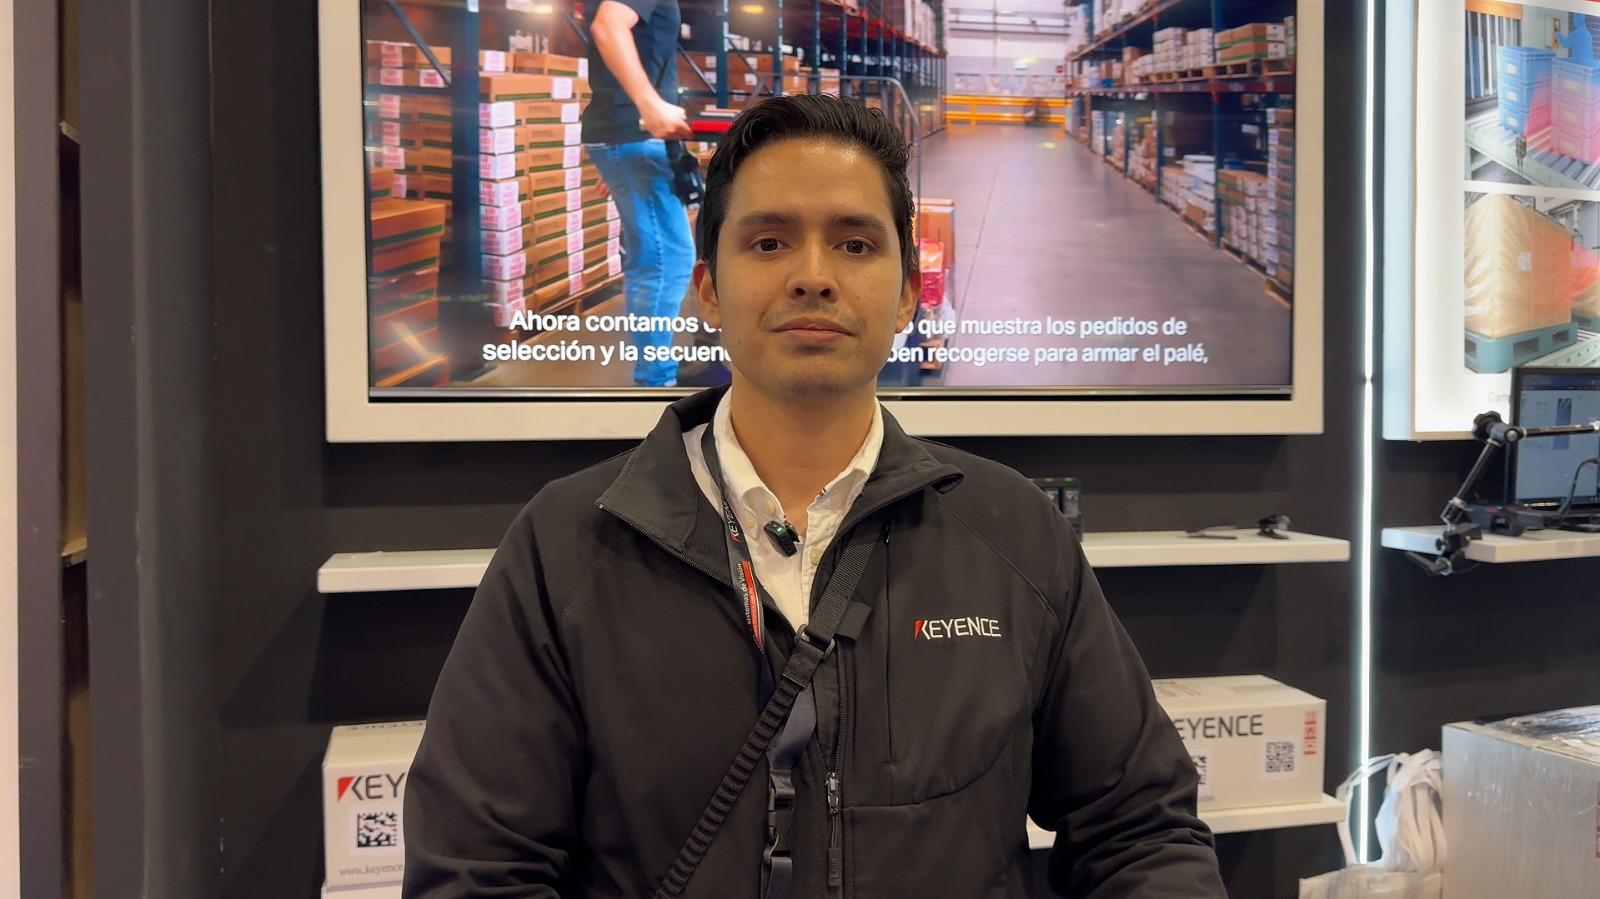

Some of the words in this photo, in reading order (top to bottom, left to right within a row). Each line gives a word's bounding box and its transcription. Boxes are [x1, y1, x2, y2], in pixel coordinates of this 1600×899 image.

[509, 309, 580, 333] Ahora
[585, 314, 699, 333] contamos
[917, 318, 957, 339] que
[960, 317, 1042, 335] muestra
[1046, 316, 1076, 335] los
[1080, 316, 1159, 339] pedidos
[1162, 316, 1188, 335] de
[482, 340, 596, 362] selección
[600, 344, 615, 366] y
[619, 340, 639, 361] la
[927, 346, 1030, 366] recogerse
[1034, 347, 1078, 366] para
[1081, 347, 1139, 362] armar
[1142, 343, 1160, 362] el
[1163, 342, 1209, 366] palé,
[914, 616, 1002, 640] KEYENCE
[1173, 714, 1264, 740] EYENCE
[337, 772, 406, 802] KEY
